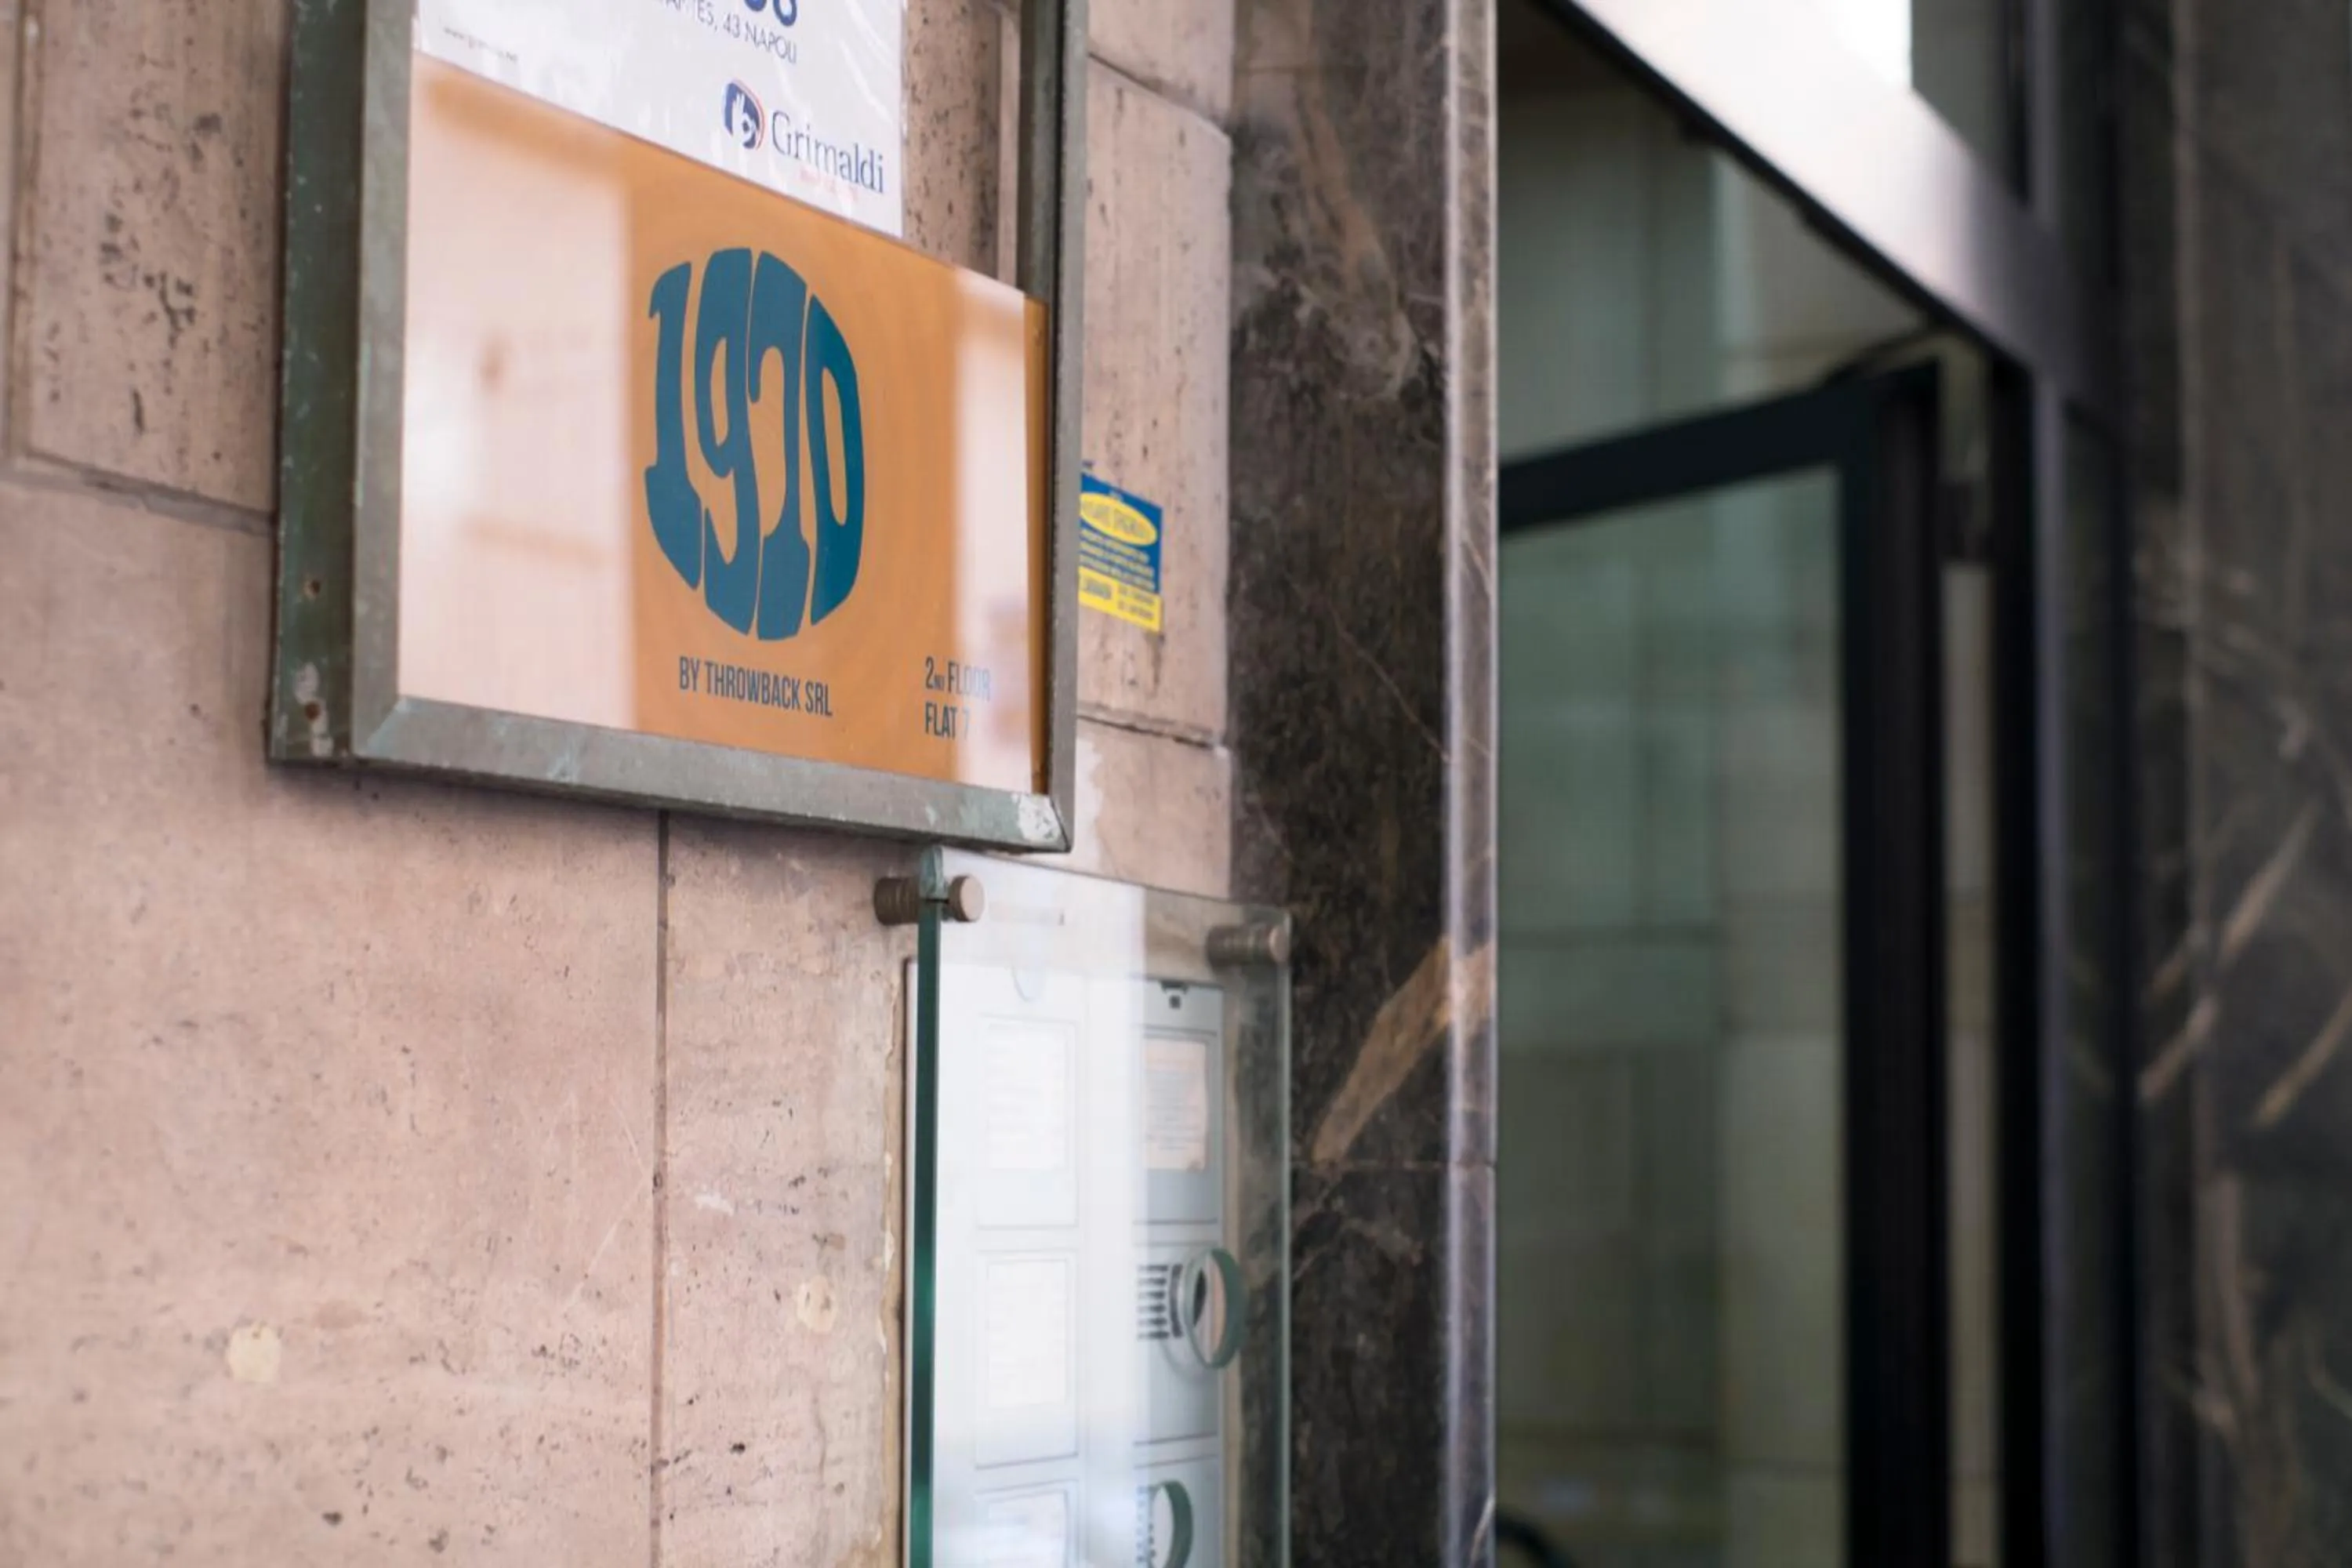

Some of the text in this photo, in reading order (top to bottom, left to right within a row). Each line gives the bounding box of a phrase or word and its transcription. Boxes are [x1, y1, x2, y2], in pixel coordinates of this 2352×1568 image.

[723, 11, 741, 38] 43
[744, 21, 797, 64] NAPOLI
[771, 110, 884, 194] Grimaldi
[644, 247, 865, 641] 1970
[679, 655, 833, 717] BY THROWBACK SRL
[924, 701, 957, 740] FLAT
